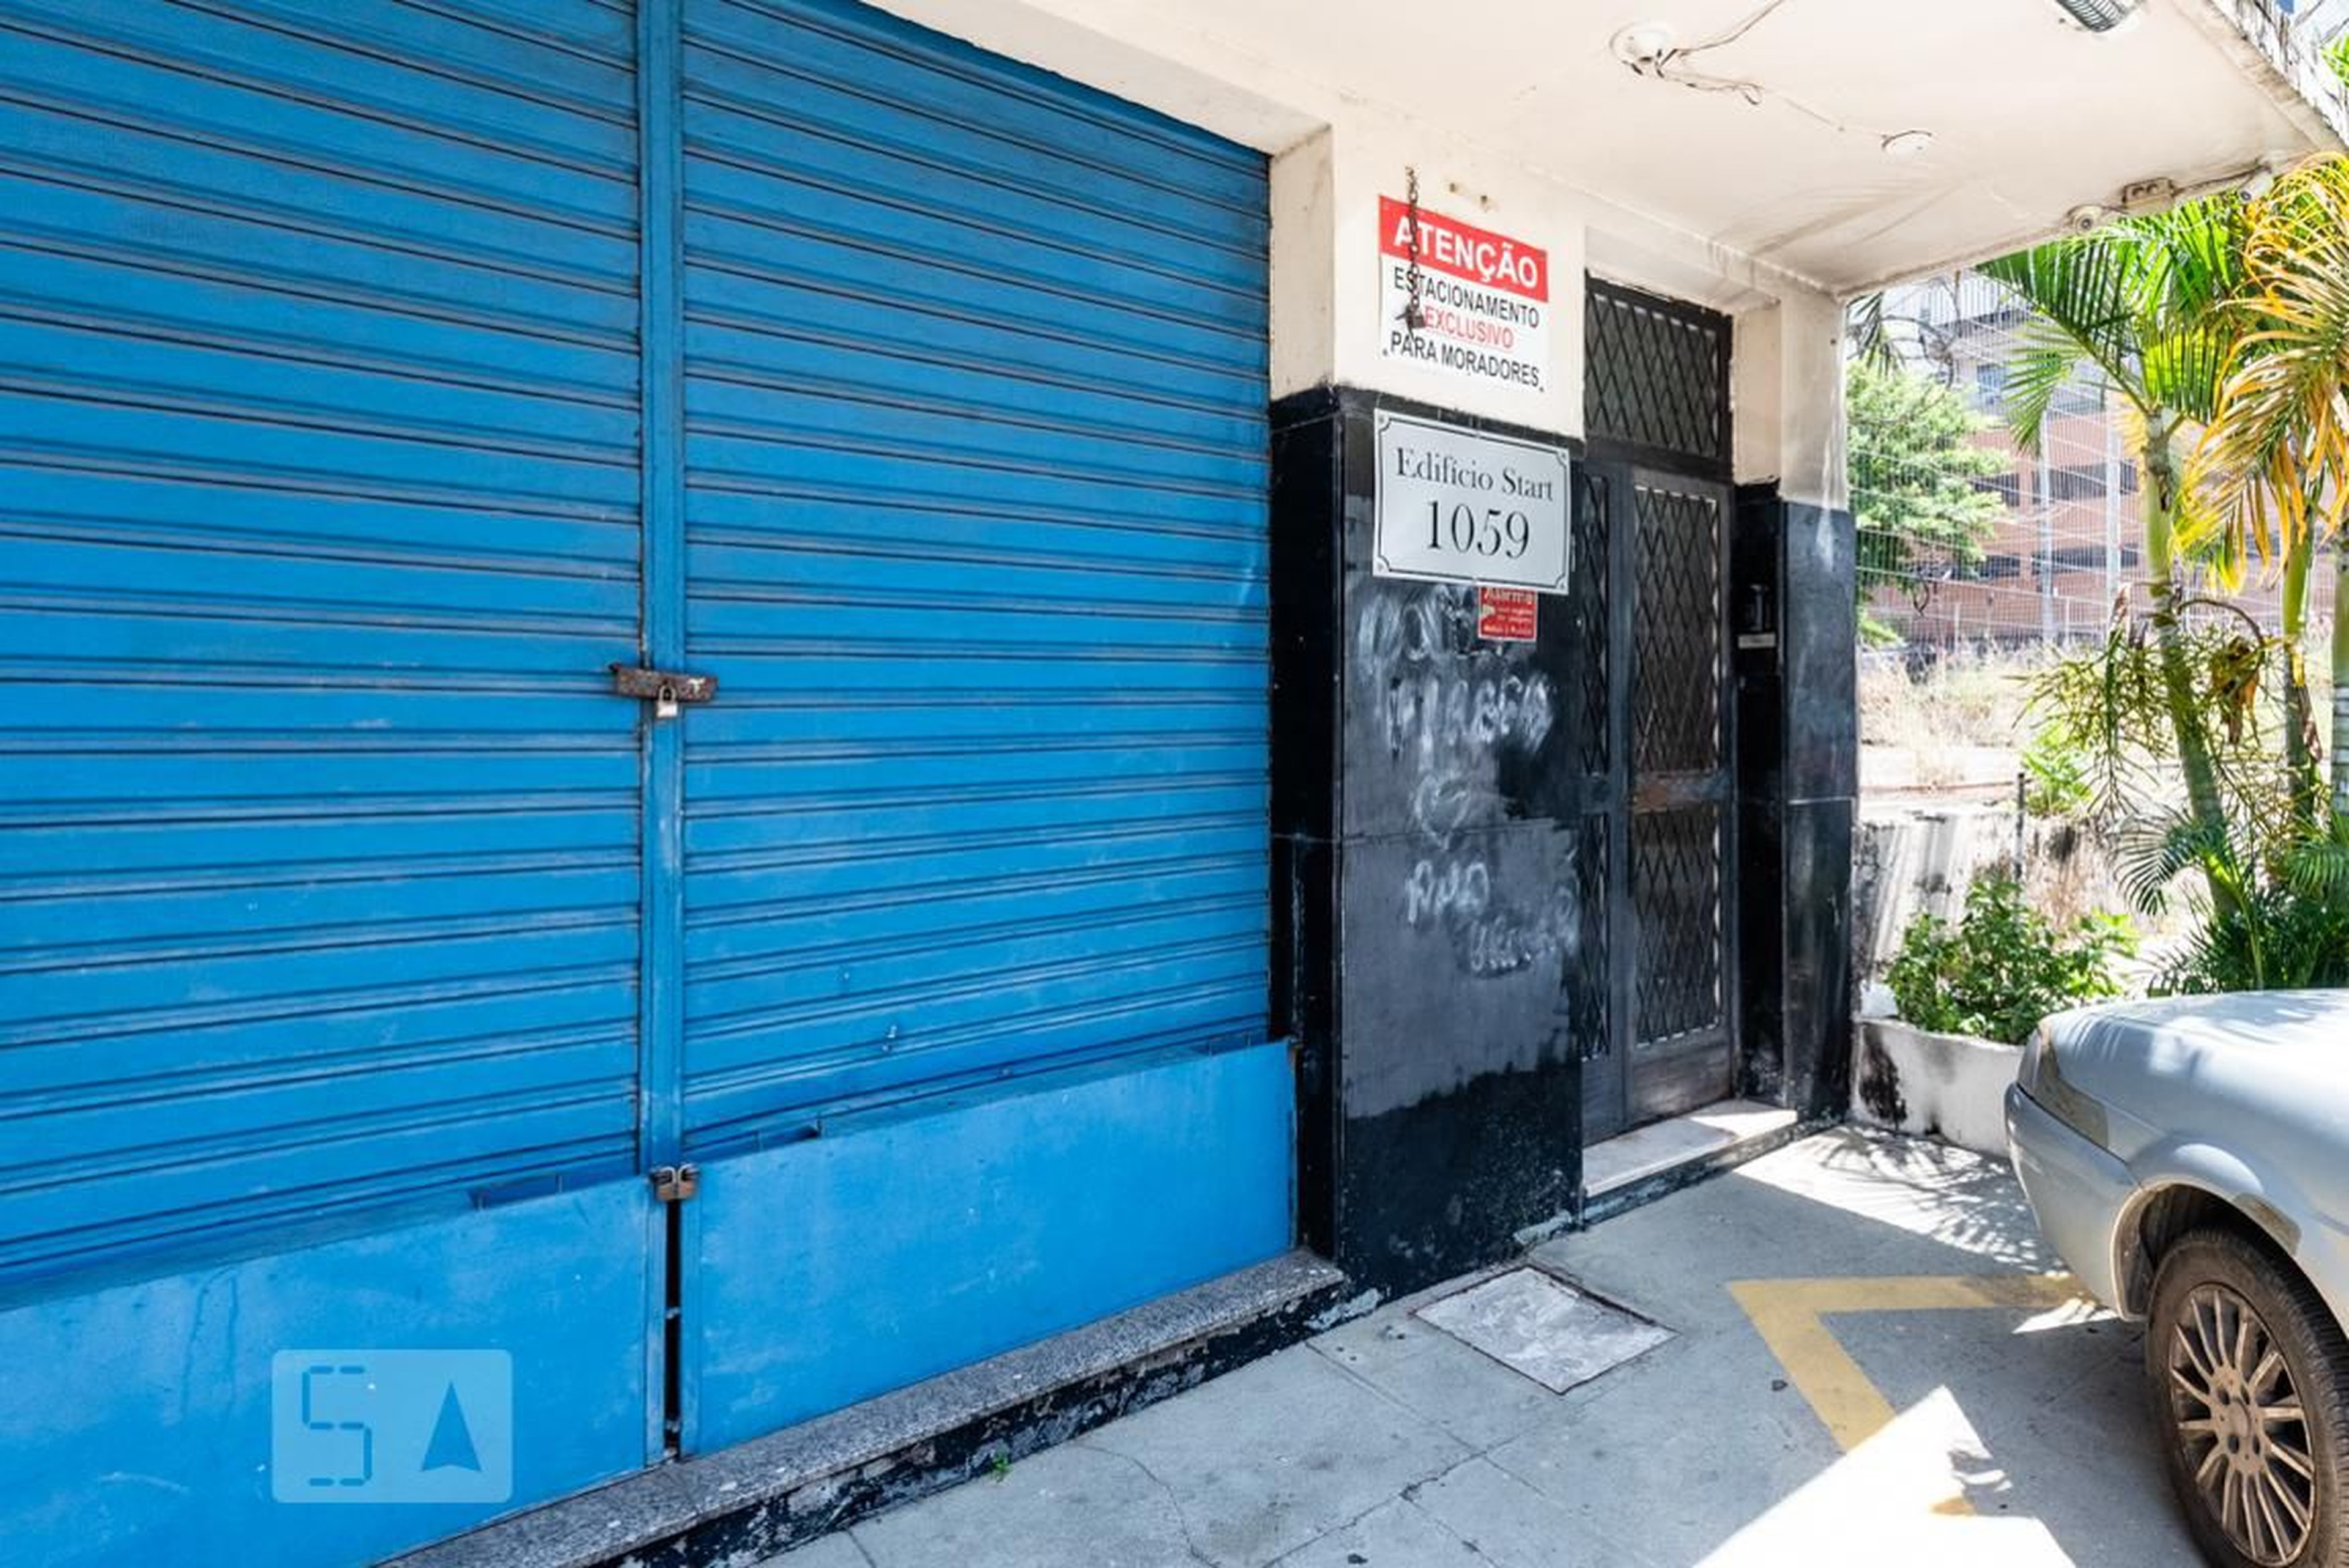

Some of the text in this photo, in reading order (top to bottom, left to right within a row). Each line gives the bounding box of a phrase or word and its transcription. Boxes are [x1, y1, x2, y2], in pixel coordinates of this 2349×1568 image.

[1393, 215, 1538, 289] ATENÇÃO
[1394, 266, 1540, 328] ESTACIONAMENTO
[1391, 331, 1438, 363] PARA
[1425, 306, 1515, 349] EXCLUSIVO
[1502, 467, 1553, 501] Start
[1428, 500, 1529, 559] 1059
